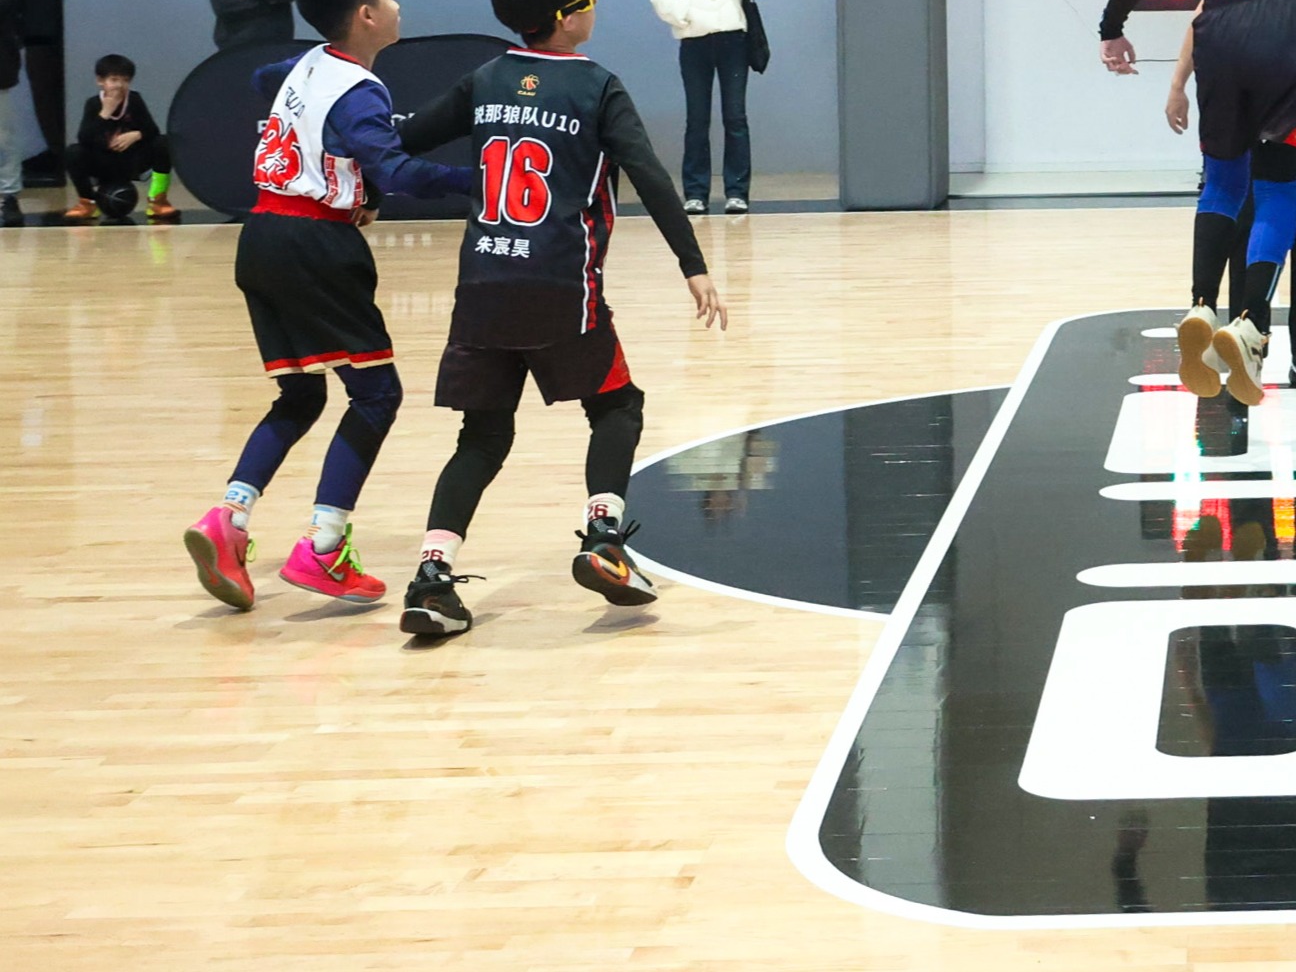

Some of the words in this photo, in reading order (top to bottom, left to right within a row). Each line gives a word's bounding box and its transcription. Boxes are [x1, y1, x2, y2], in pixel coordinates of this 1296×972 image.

[477, 135, 553, 227] 16
[474, 235, 531, 259] 朱宸昊
